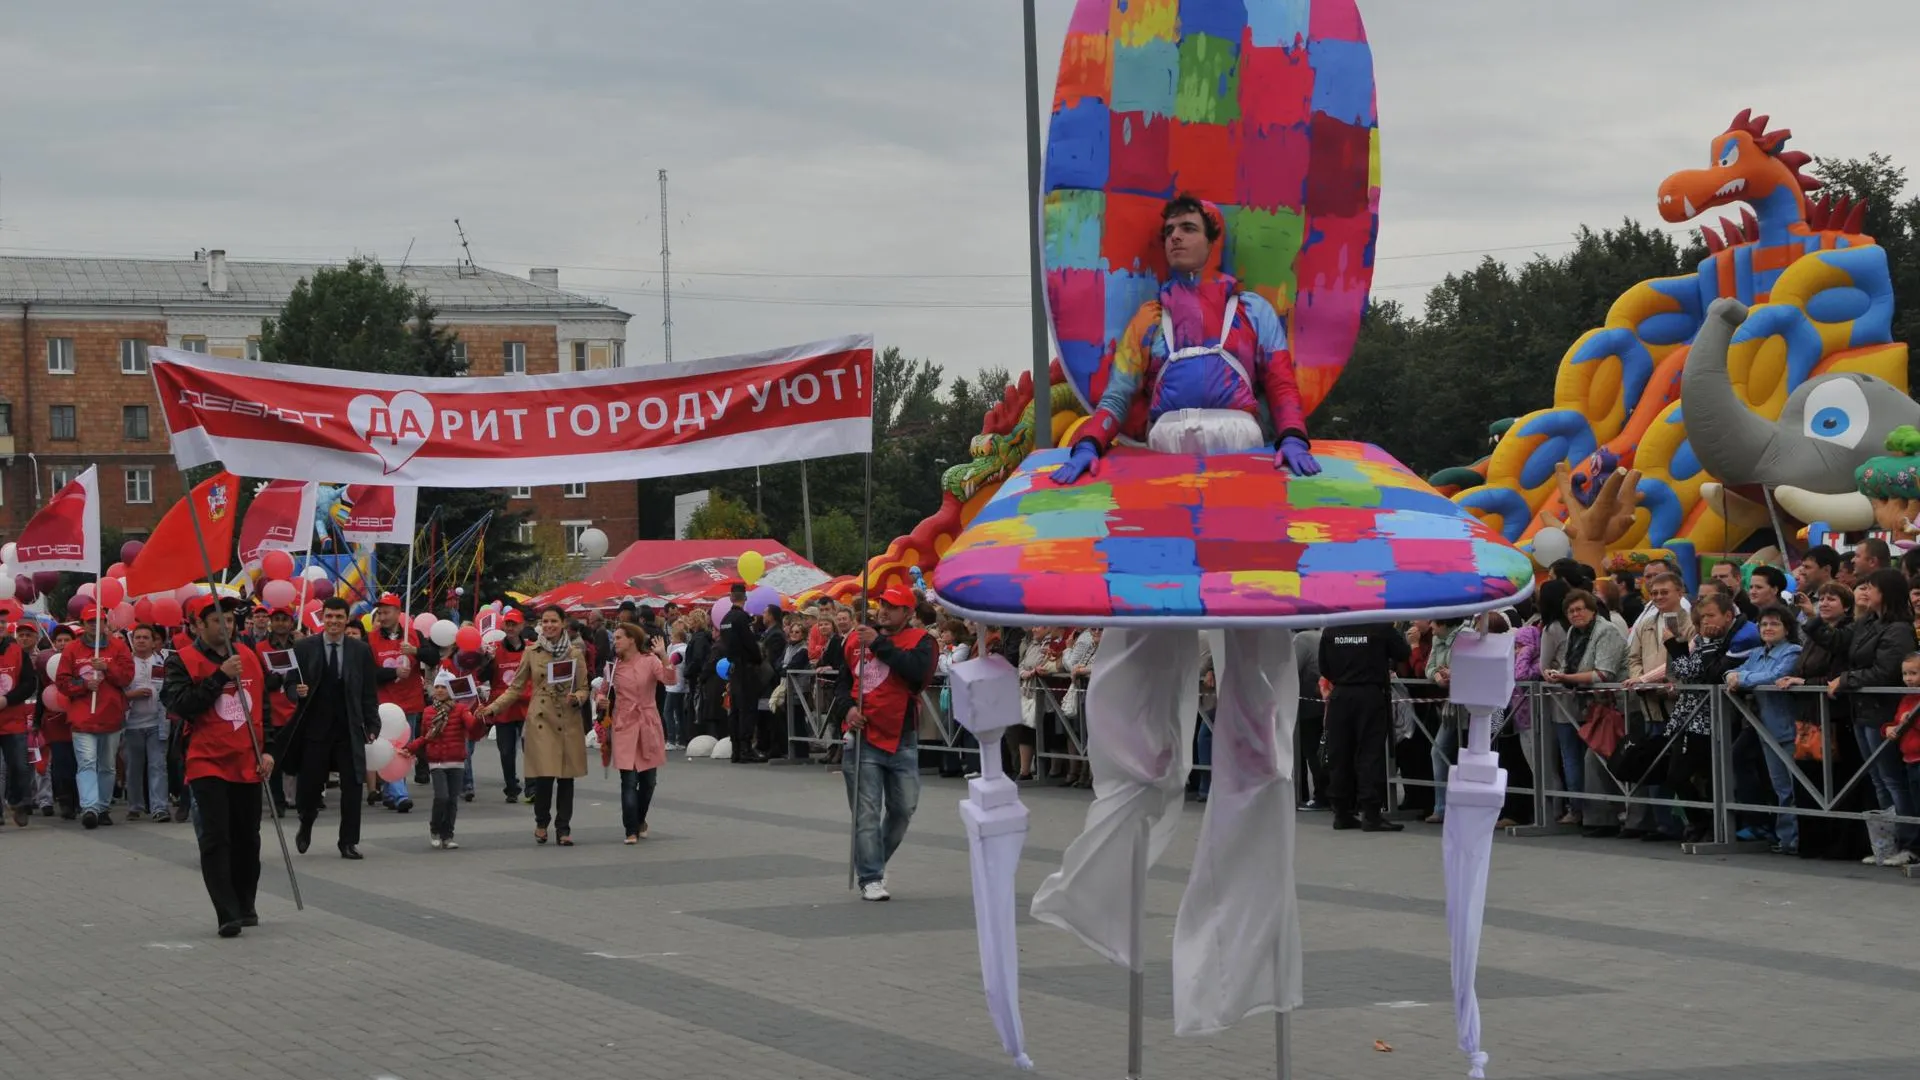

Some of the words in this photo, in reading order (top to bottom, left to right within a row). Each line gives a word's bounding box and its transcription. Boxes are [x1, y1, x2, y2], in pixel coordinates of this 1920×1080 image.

[178, 389, 334, 429] ДЕБЮТ
[365, 407, 528, 446] ДАРИТ
[545, 388, 733, 439] ГОРОДУ
[747, 364, 863, 413] УЮТ!
[1334, 636, 1368, 645] ПОЛИЦИЯ
